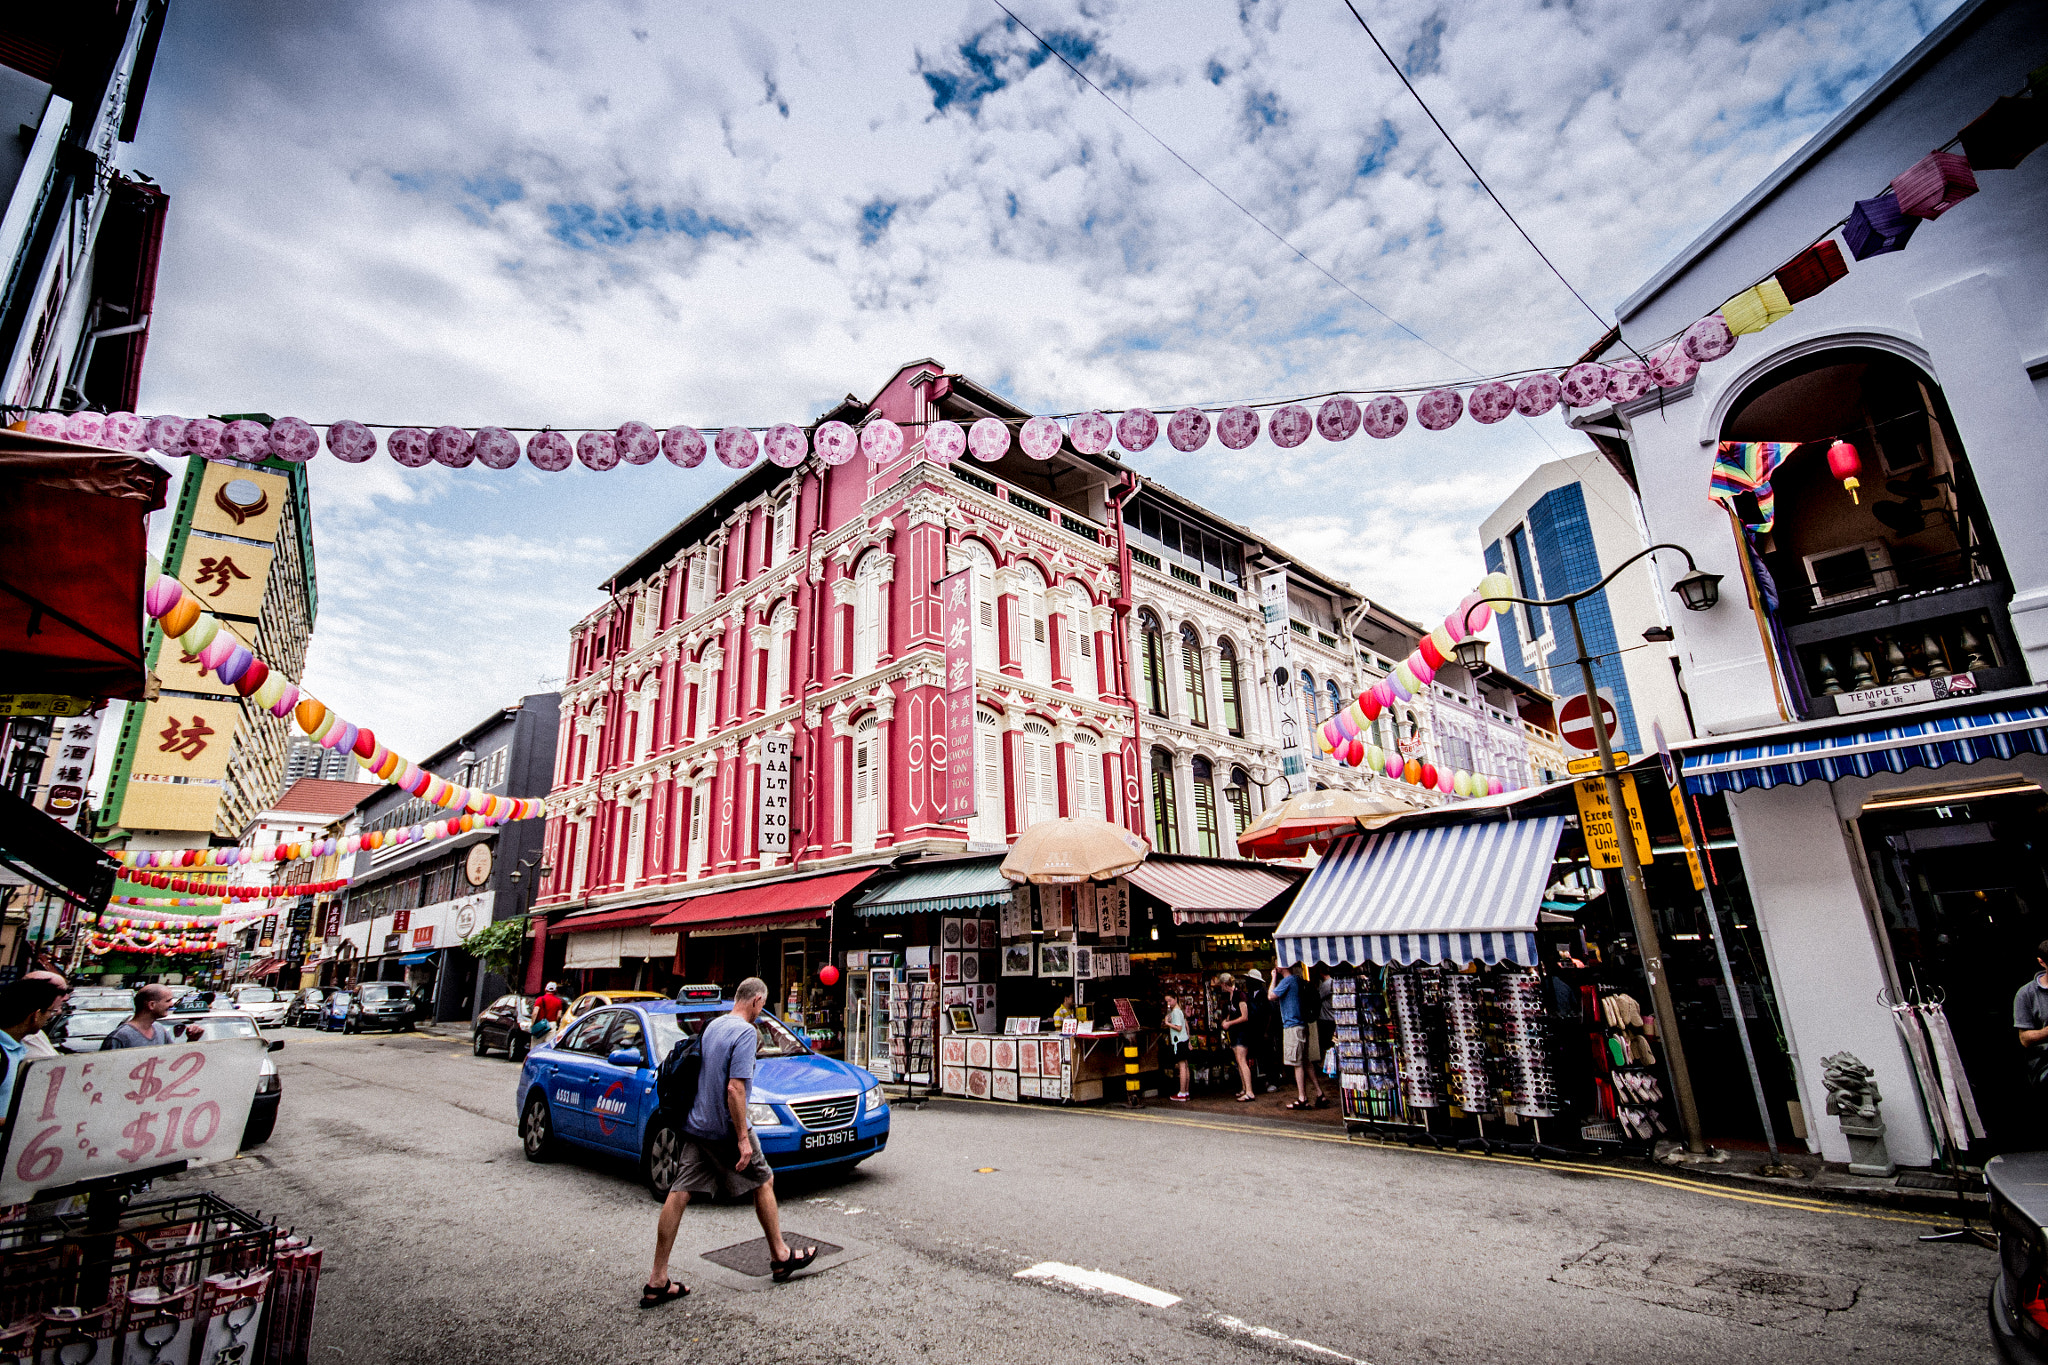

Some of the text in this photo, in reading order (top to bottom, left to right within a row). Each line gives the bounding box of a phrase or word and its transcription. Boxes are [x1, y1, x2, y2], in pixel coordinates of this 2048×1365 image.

[159, 556, 252, 761] 珍坊
[1848, 683, 1916, 702] TEMPLE ST
[951, 734, 969, 748] CHOP
[952, 777, 970, 789] TONG
[1582, 778, 1625, 793] Vehis
[765, 741, 776, 845] GALAXY
[777, 743, 788, 845] TATTOO
[953, 795, 968, 812] 16
[1587, 823, 1613, 836] 2500
[183, 1002, 205, 1010] TAXI
[37, 1052, 206, 1122] 1 FOR $2
[556, 1088, 570, 1103] 6552
[597, 1095, 627, 1114] Comfort
[17, 1100, 221, 1182] 6 FOR $10
